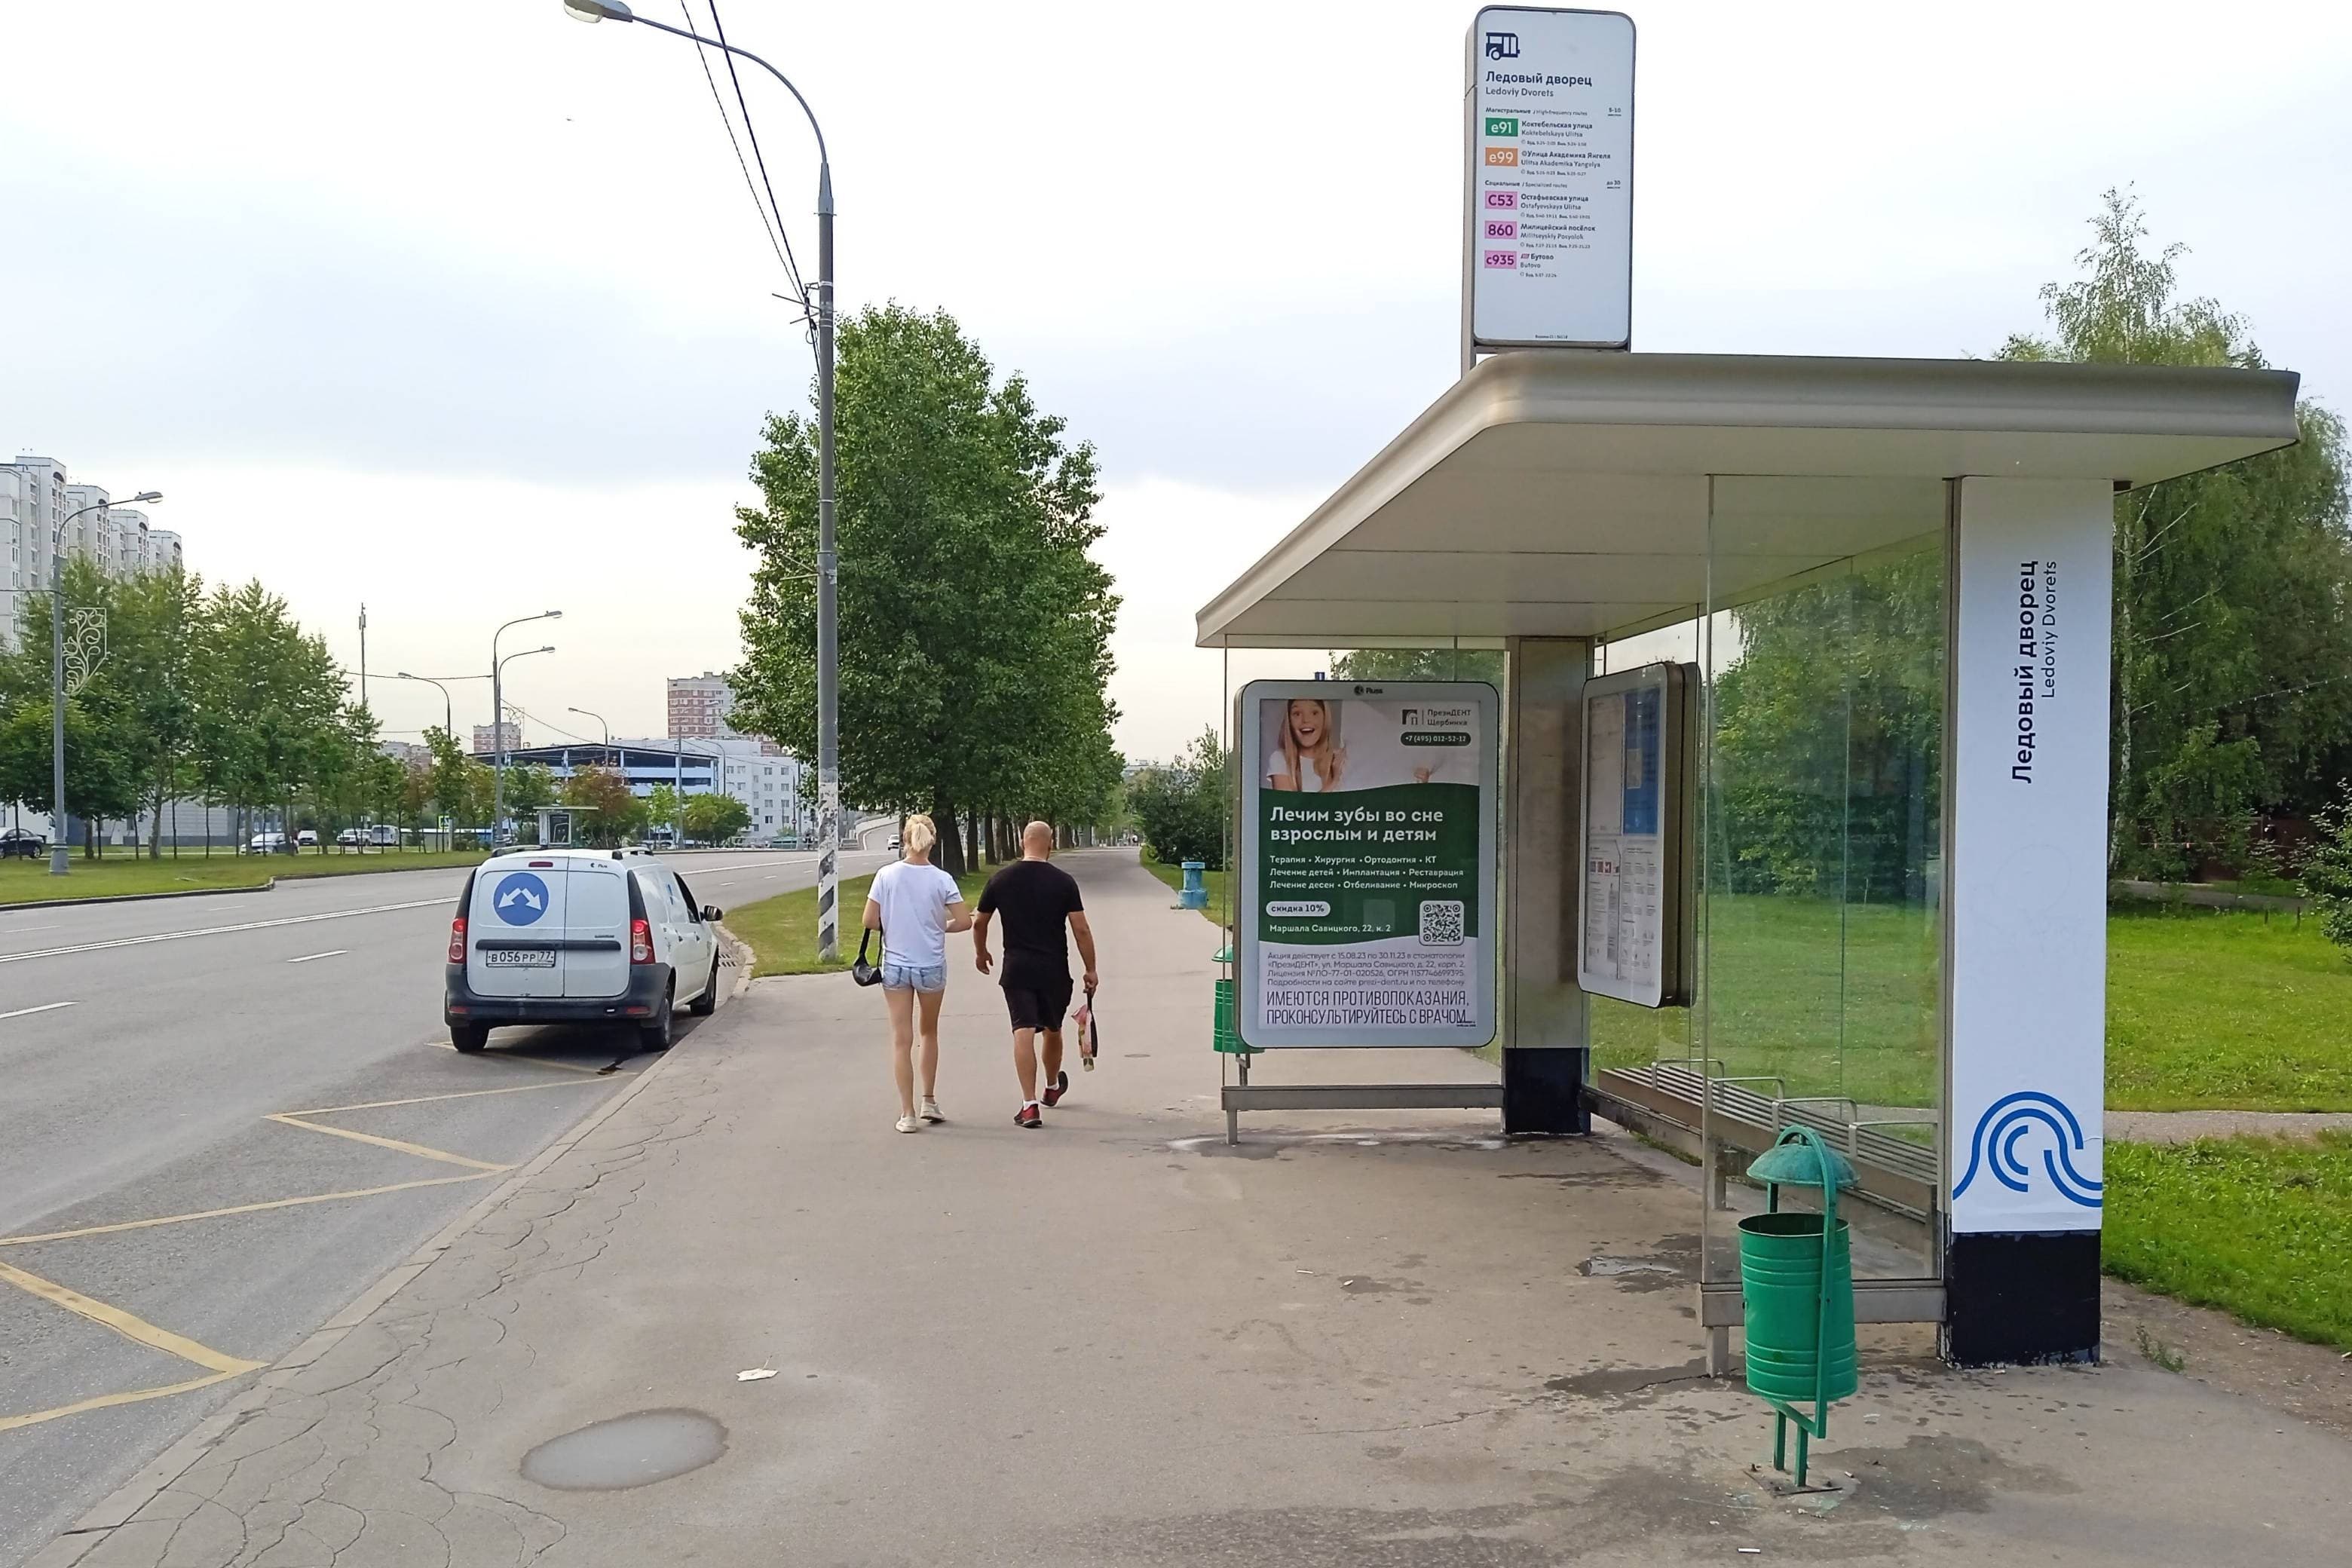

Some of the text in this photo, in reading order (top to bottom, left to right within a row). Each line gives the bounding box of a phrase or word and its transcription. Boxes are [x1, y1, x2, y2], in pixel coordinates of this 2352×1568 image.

[1485, 71, 1592, 87] Ледовый дворец
[1485, 87, 1554, 97] Ledoviy Dvorets
[1490, 121, 1512, 133] е91
[1489, 151, 1514, 164] е99
[1521, 193, 1568, 201] Остафьевская
[1488, 224, 1514, 236] 860
[2041, 561, 2059, 698] Ledoviy Dvorets
[2012, 561, 2038, 784] Ледовый дворец
[1427, 709, 1472, 717] ПрезиДЕНТ
[1270, 806, 1444, 826] Лечим зубы во сне
[1270, 829, 1437, 845] взрослым и детям
[1269, 855, 1306, 865] Терапия
[1314, 855, 1355, 865] Хирургия
[1364, 856, 1416, 865] Ортодонтия
[1269, 868, 1306, 876] Лечение
[1309, 868, 1334, 877] детей
[1408, 868, 1464, 878] Реставрация
[1269, 880, 1306, 889] Лечение
[1343, 880, 1401, 889] Отбеливание
[1409, 881, 1458, 890] Микроскоп
[1271, 904, 1325, 913] скидка 10%
[1269, 924, 1309, 934] Маршала
[1311, 924, 1361, 933] Савицкого,
[539, 951, 551, 960] 77
[1291, 952, 1330, 960] действует
[1334, 960, 1372, 969] Маршала
[1374, 960, 1416, 969] Савицкого,
[1267, 978, 1321, 987] Подробности
[1266, 991, 1469, 1006] ИМЕЮТСЯ ПРОТИВОПОКАЗАНИЯ,
[1266, 1006, 1407, 1024] ПРОКОНСУЛЬТИРУЙТЕСЬ
[1409, 1009, 1417, 1024] С
